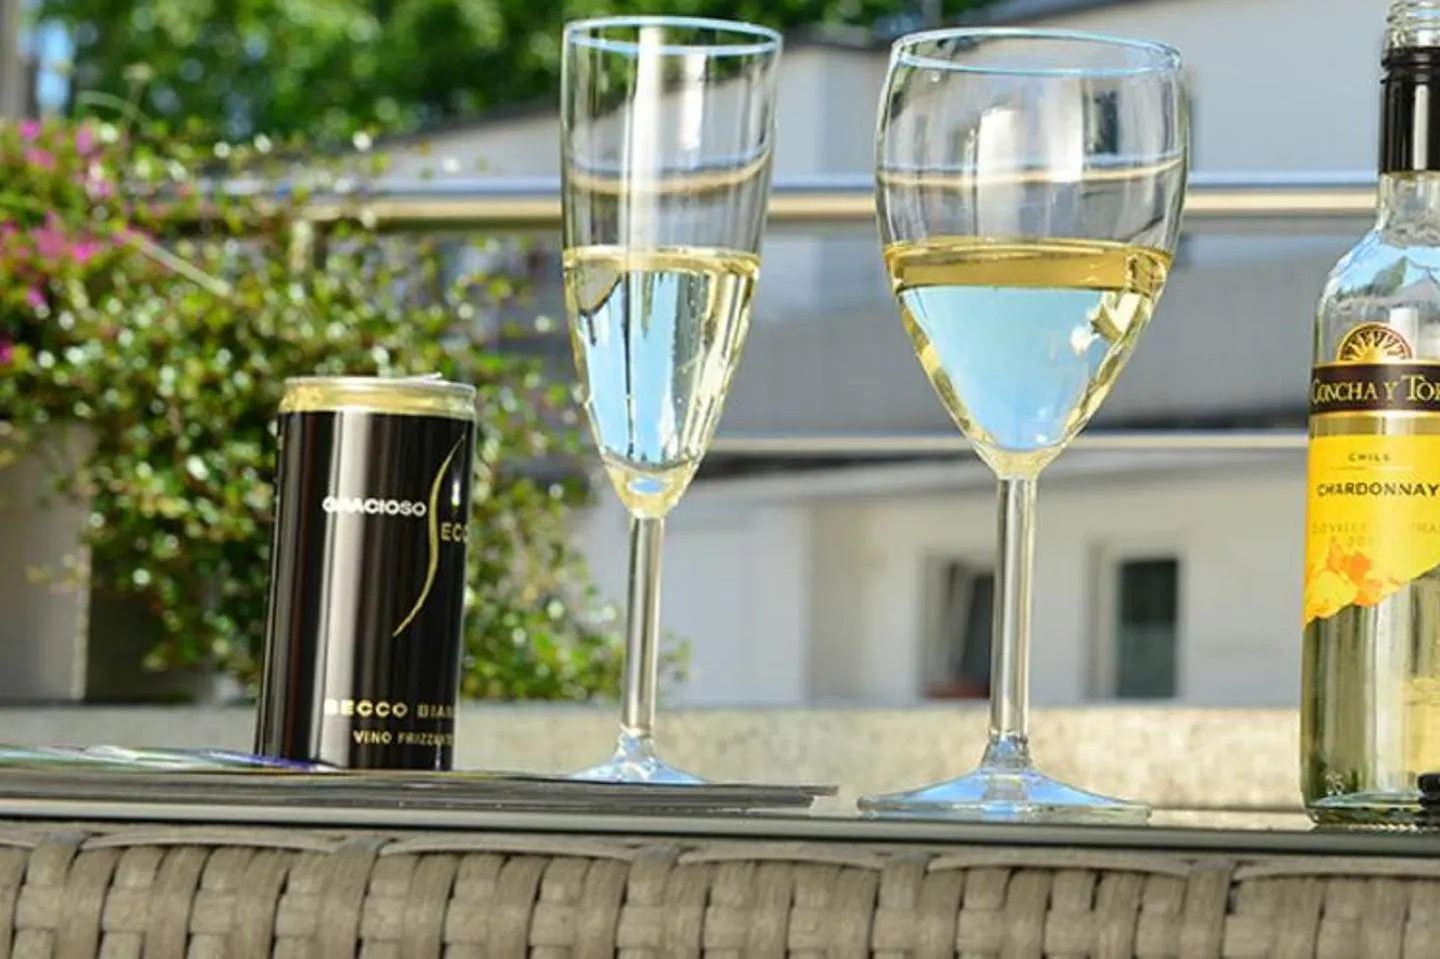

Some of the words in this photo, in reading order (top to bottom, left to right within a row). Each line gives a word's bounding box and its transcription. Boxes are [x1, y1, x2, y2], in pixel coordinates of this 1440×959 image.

[1384, 381, 1399, 402] Y
[1315, 480, 1440, 498] CHARDONNAY
[322, 496, 427, 517] GACIOSO
[323, 698, 409, 719] ECCO
